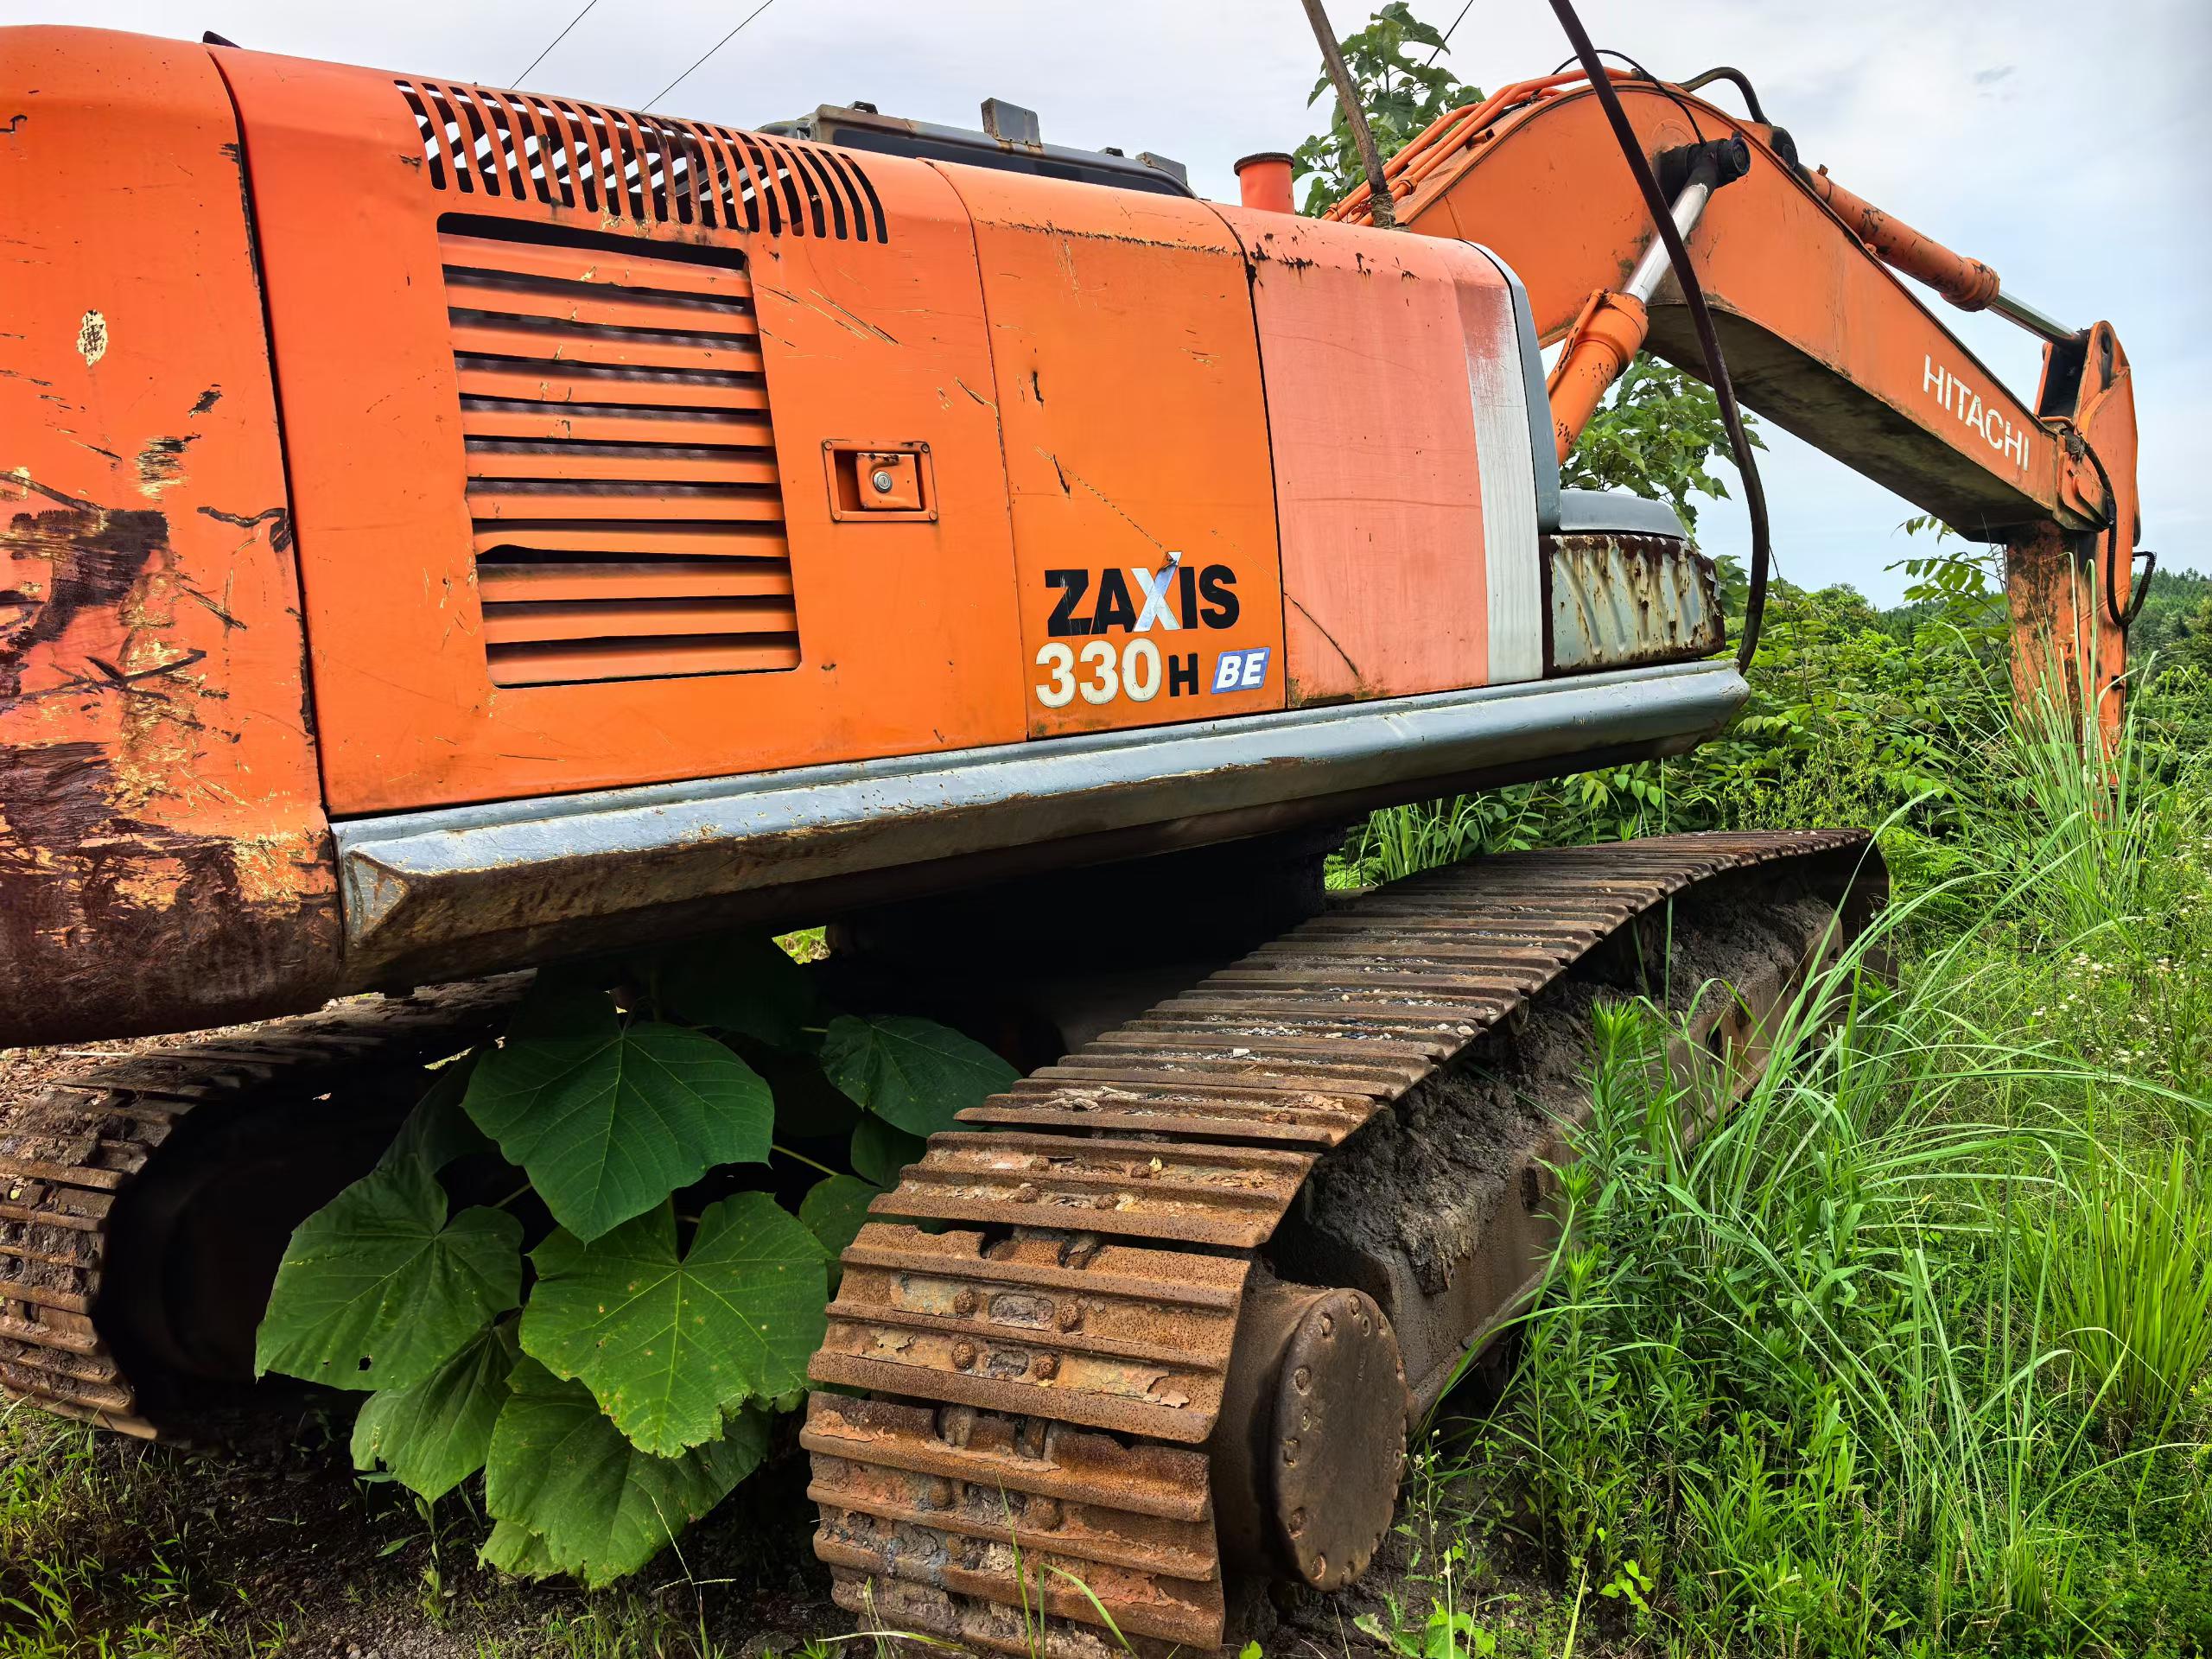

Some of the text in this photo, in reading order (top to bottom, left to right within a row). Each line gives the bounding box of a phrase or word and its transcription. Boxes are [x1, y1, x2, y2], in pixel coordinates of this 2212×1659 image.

[1923, 354, 2029, 471] HITACHI
[1045, 551, 1240, 637] ZAXIS
[1216, 652, 1266, 690] BE
